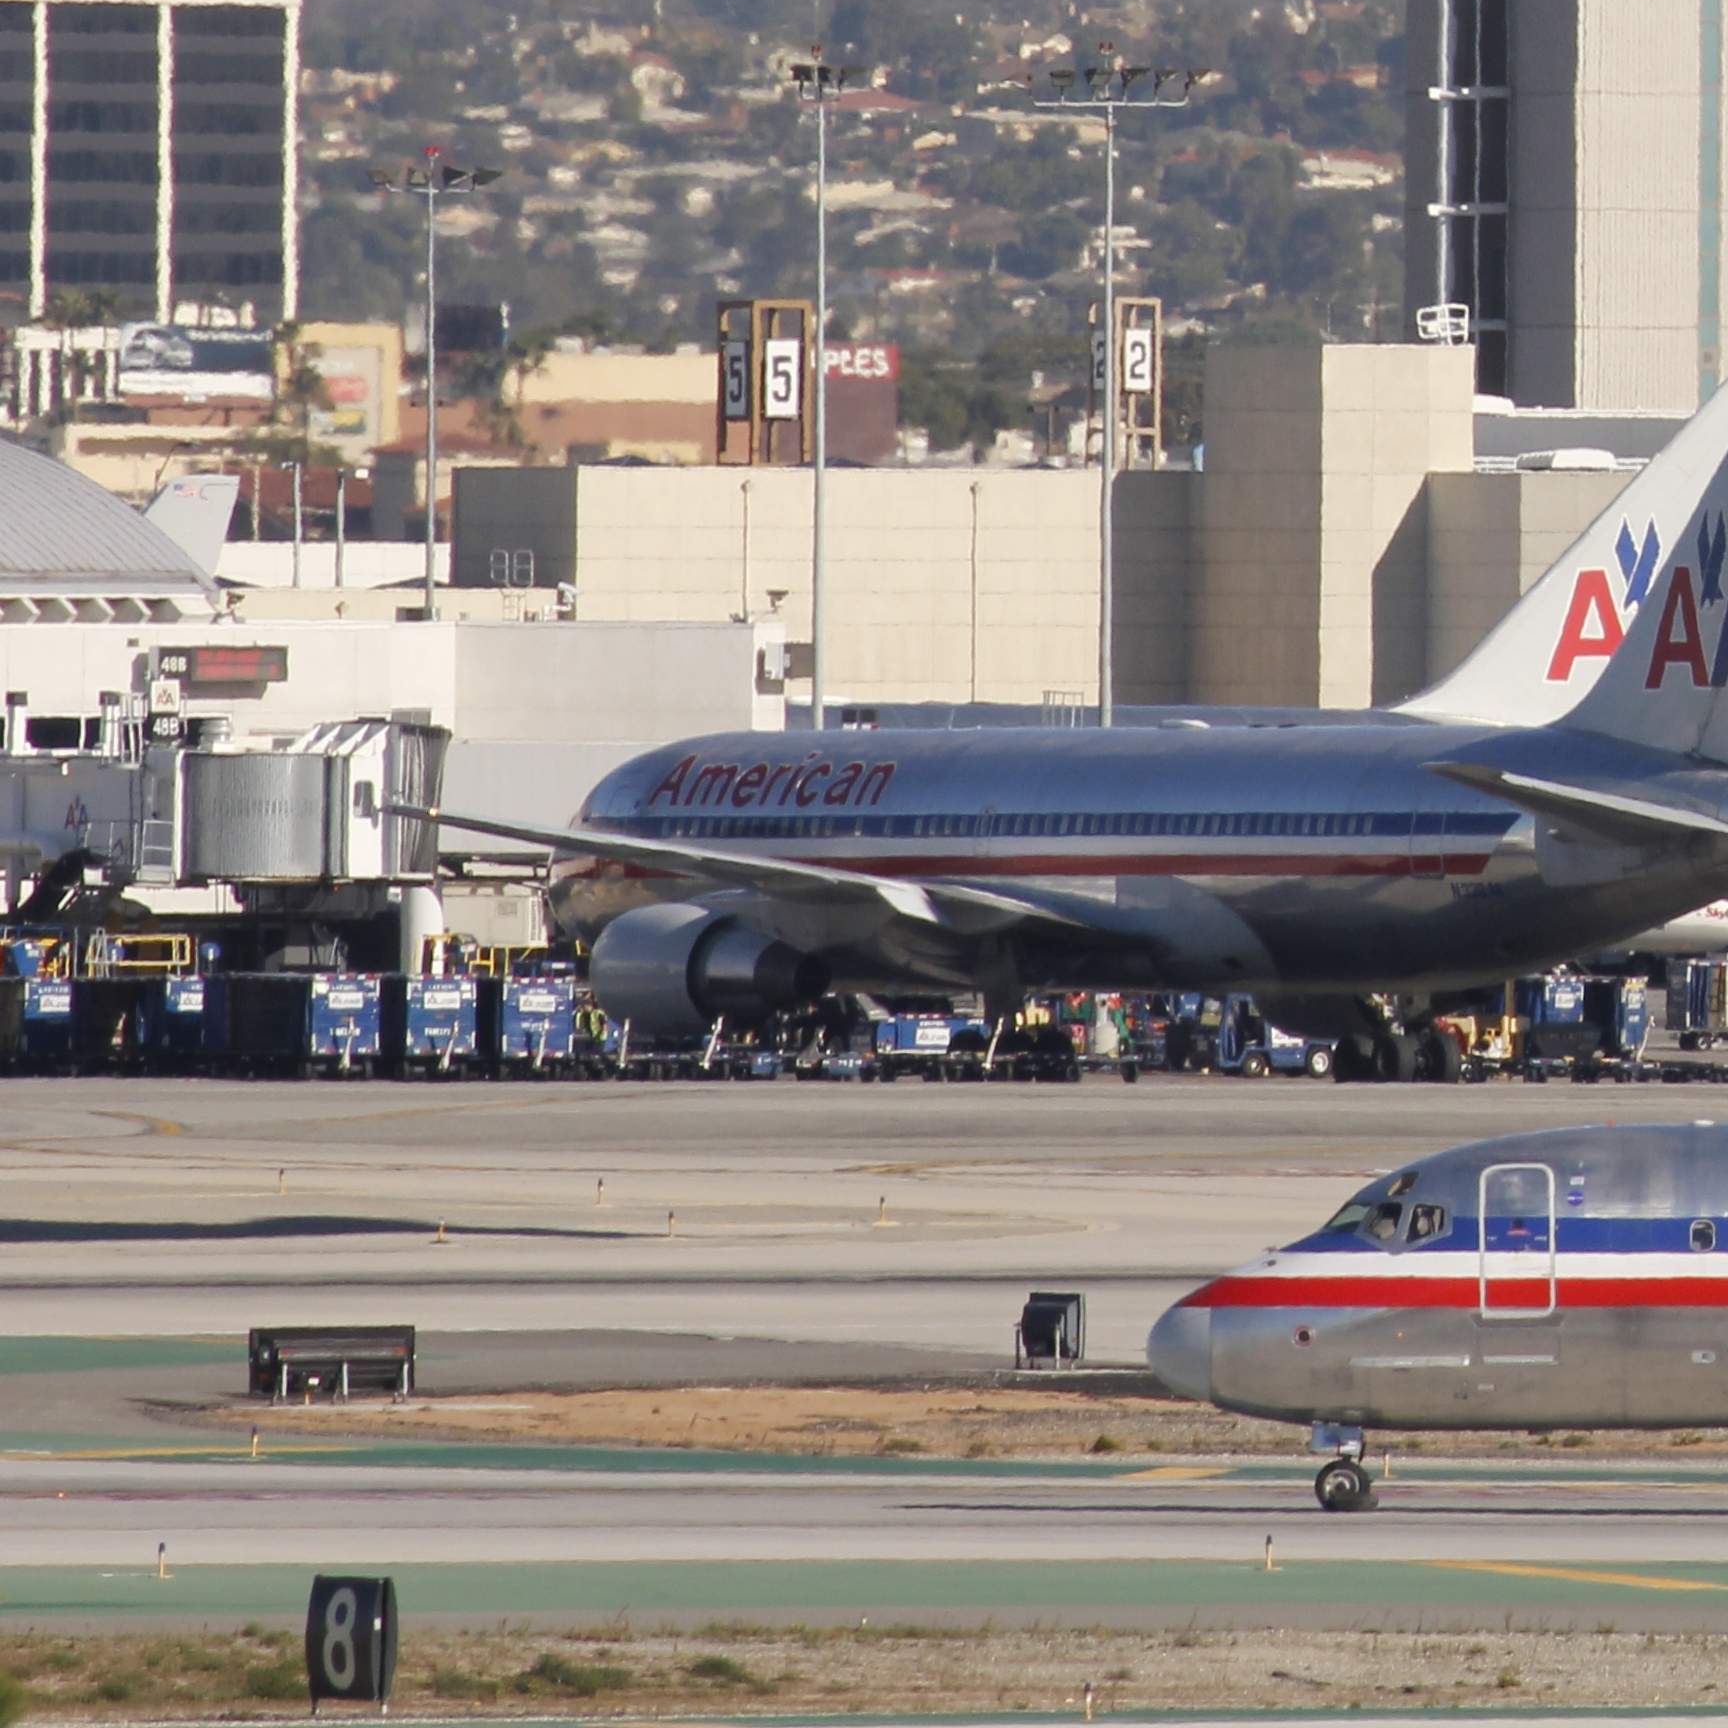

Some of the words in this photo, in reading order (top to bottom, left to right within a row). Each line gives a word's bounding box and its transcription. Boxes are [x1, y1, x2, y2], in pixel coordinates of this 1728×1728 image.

[729, 355, 743, 403] 5
[772, 355, 792, 402] 5
[811, 347, 889, 377] PLES
[1129, 341, 1146, 379] 2
[160, 656, 187, 672] 48B
[152, 717, 180, 735] 48B
[648, 750, 898, 808] American
[323, 1587, 356, 1690] 8
